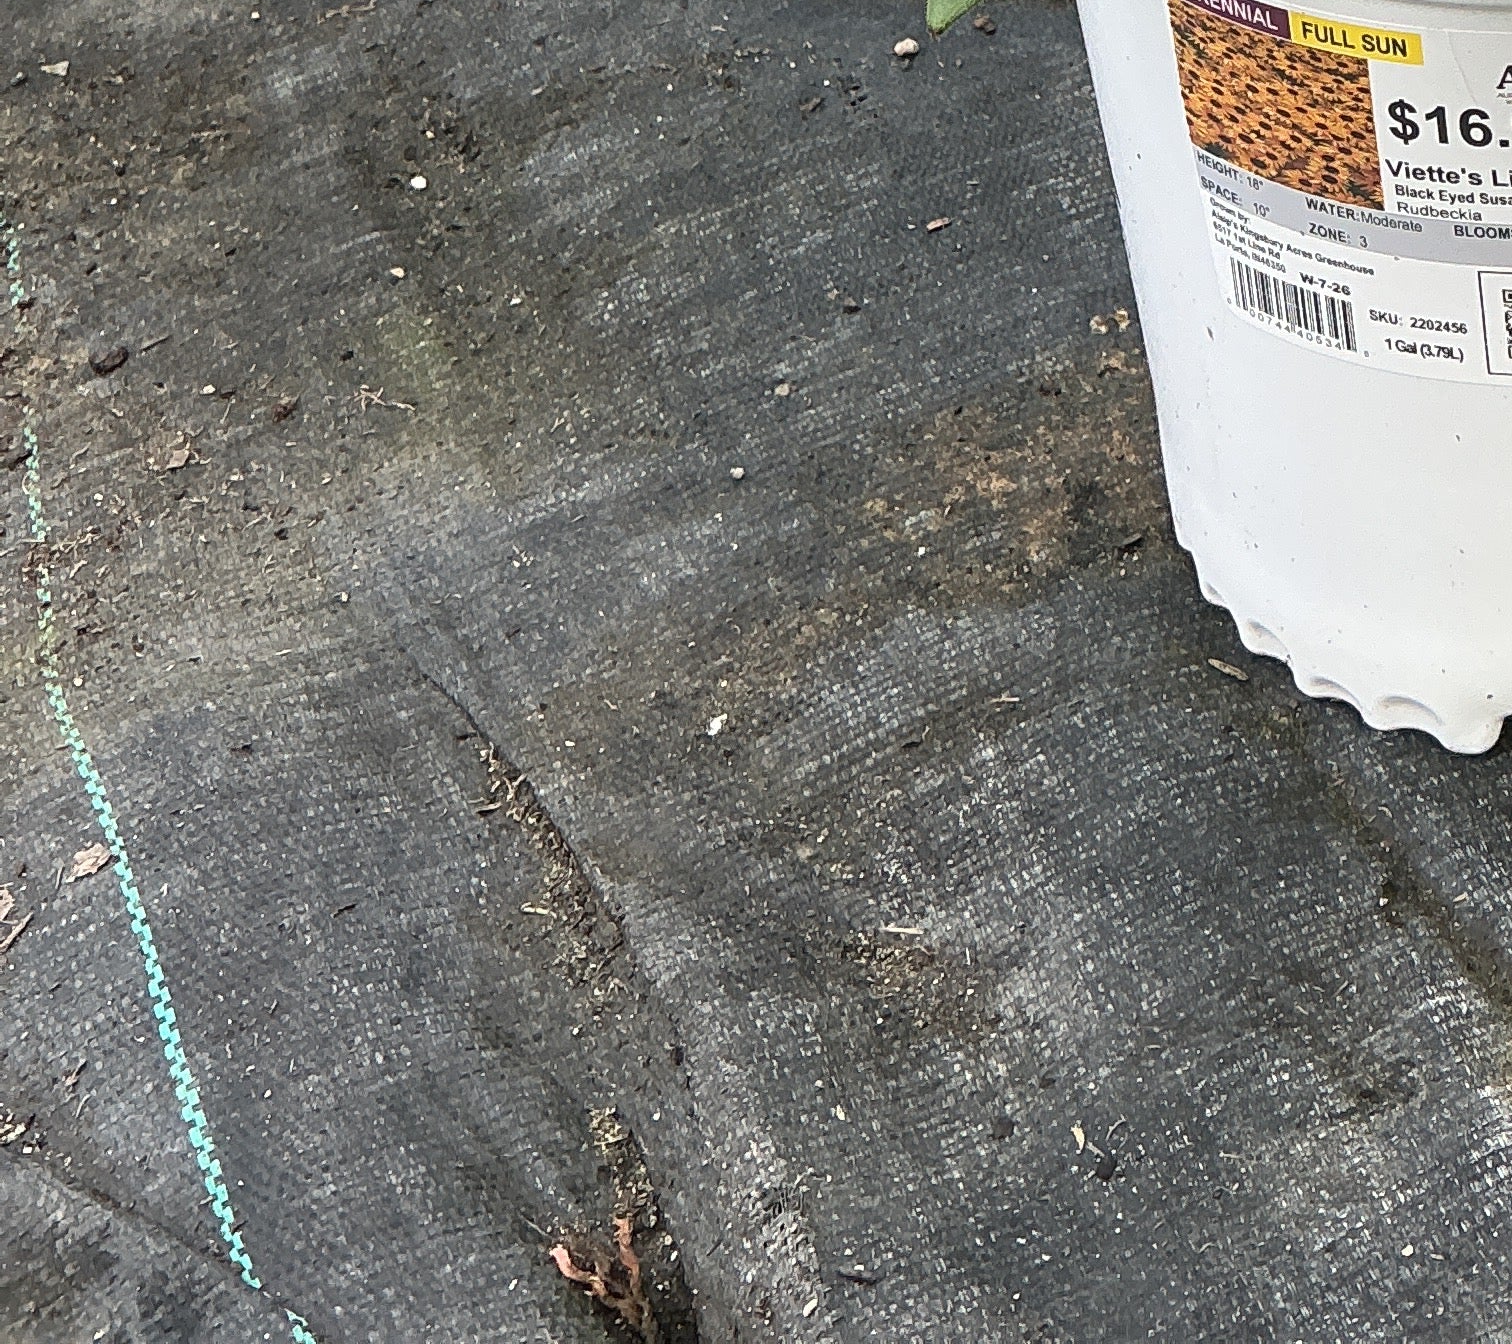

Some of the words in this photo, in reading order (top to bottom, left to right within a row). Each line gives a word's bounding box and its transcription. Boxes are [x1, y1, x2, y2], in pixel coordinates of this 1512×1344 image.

[1301, 20, 1356, 50] FULL
[1362, 33, 1408, 58] SUN
[1197, 150, 1245, 184] HEIGHT:
[1246, 175, 1264, 191] 18"
[1385, 158, 1484, 187] Viette's
[1200, 175, 1243, 206] SPACE:
[1395, 184, 1435, 201] Black
[1439, 190, 1475, 206] Eyed
[1396, 201, 1483, 222] Rudbeckia
[1308, 222, 1350, 244] ZONE:
[1359, 235, 1369, 249] 3
[1286, 243, 1313, 260] Acres
[1315, 253, 1375, 276] Greenhouse
[1299, 272, 1352, 297] W-7-26
[1369, 309, 1403, 326] SKU:
[1409, 317, 1468, 335] 2202456
[1384, 338, 1392, 350] 1
[1395, 340, 1418, 354] Gal
[1420, 343, 1465, 363] (3.79L)
